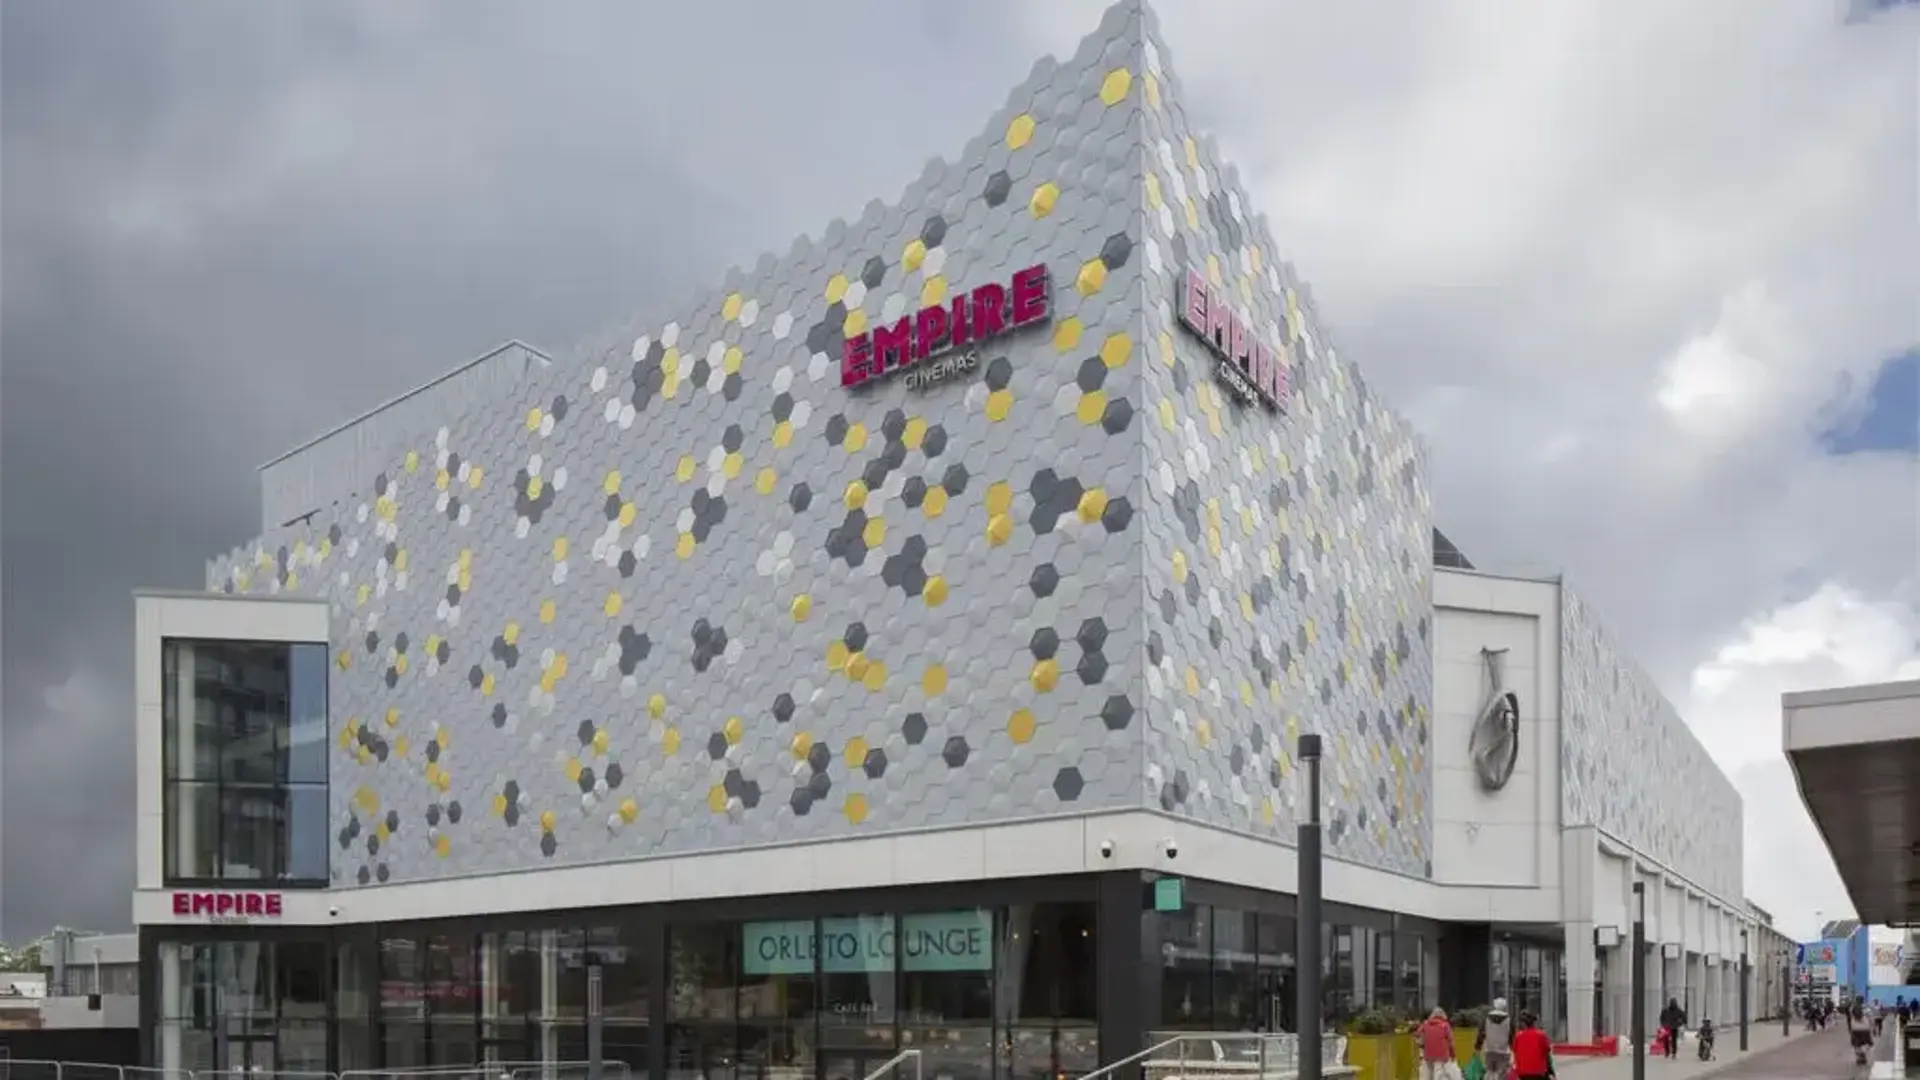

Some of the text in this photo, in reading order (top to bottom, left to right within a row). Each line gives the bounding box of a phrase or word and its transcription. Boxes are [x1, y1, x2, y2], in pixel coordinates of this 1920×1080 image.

[840, 262, 1049, 387] EMPIRE
[1185, 267, 1291, 411] EMPIRE
[903, 351, 978, 391] CINEMAS
[173, 893, 282, 915] EMPIRE
